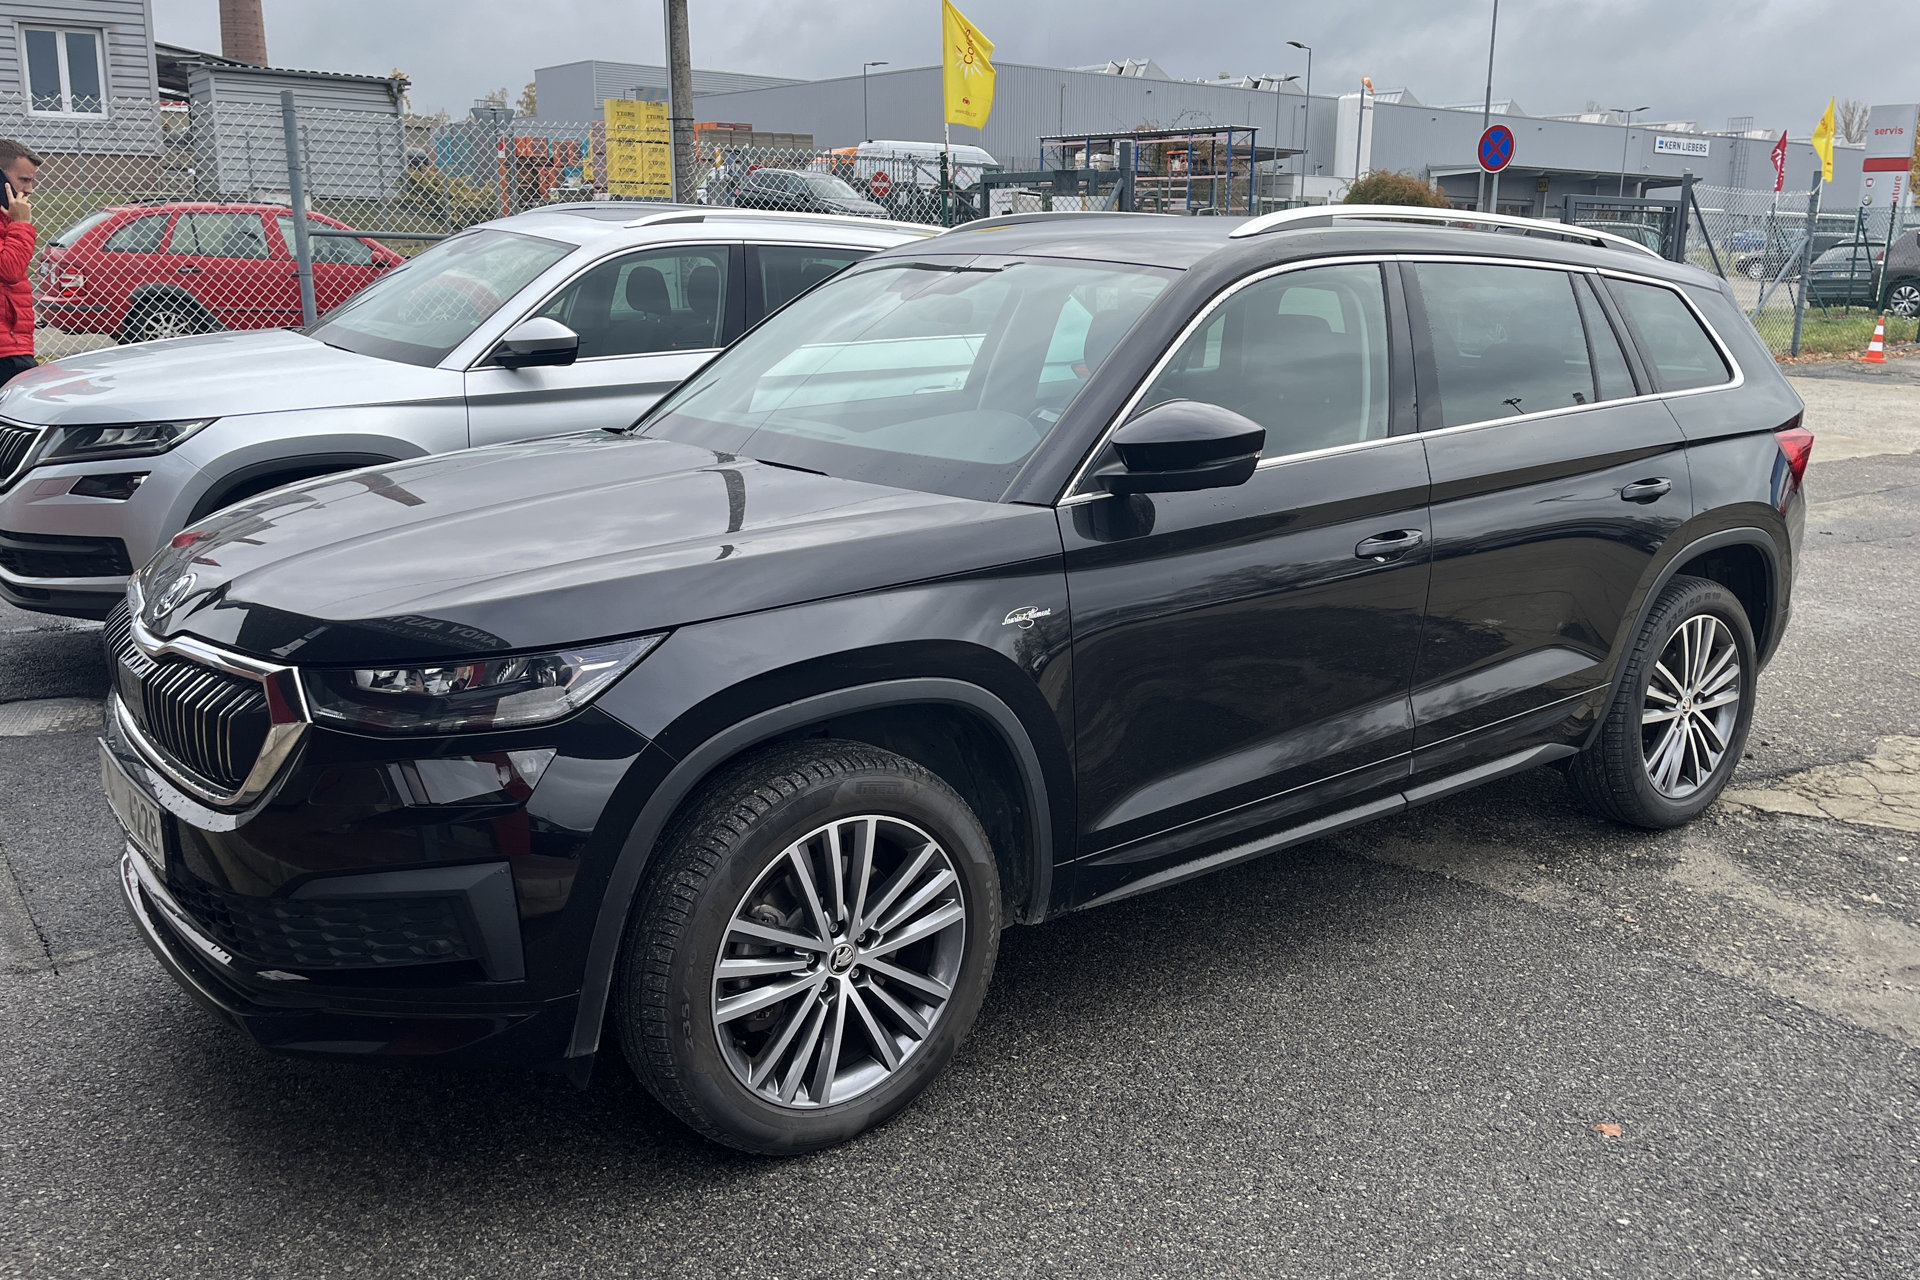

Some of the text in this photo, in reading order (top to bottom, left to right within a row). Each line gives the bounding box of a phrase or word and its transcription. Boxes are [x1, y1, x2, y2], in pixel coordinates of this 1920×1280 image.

[1874, 126, 1904, 136] servis
[1664, 140, 1707, 153] KERN LIEBERS
